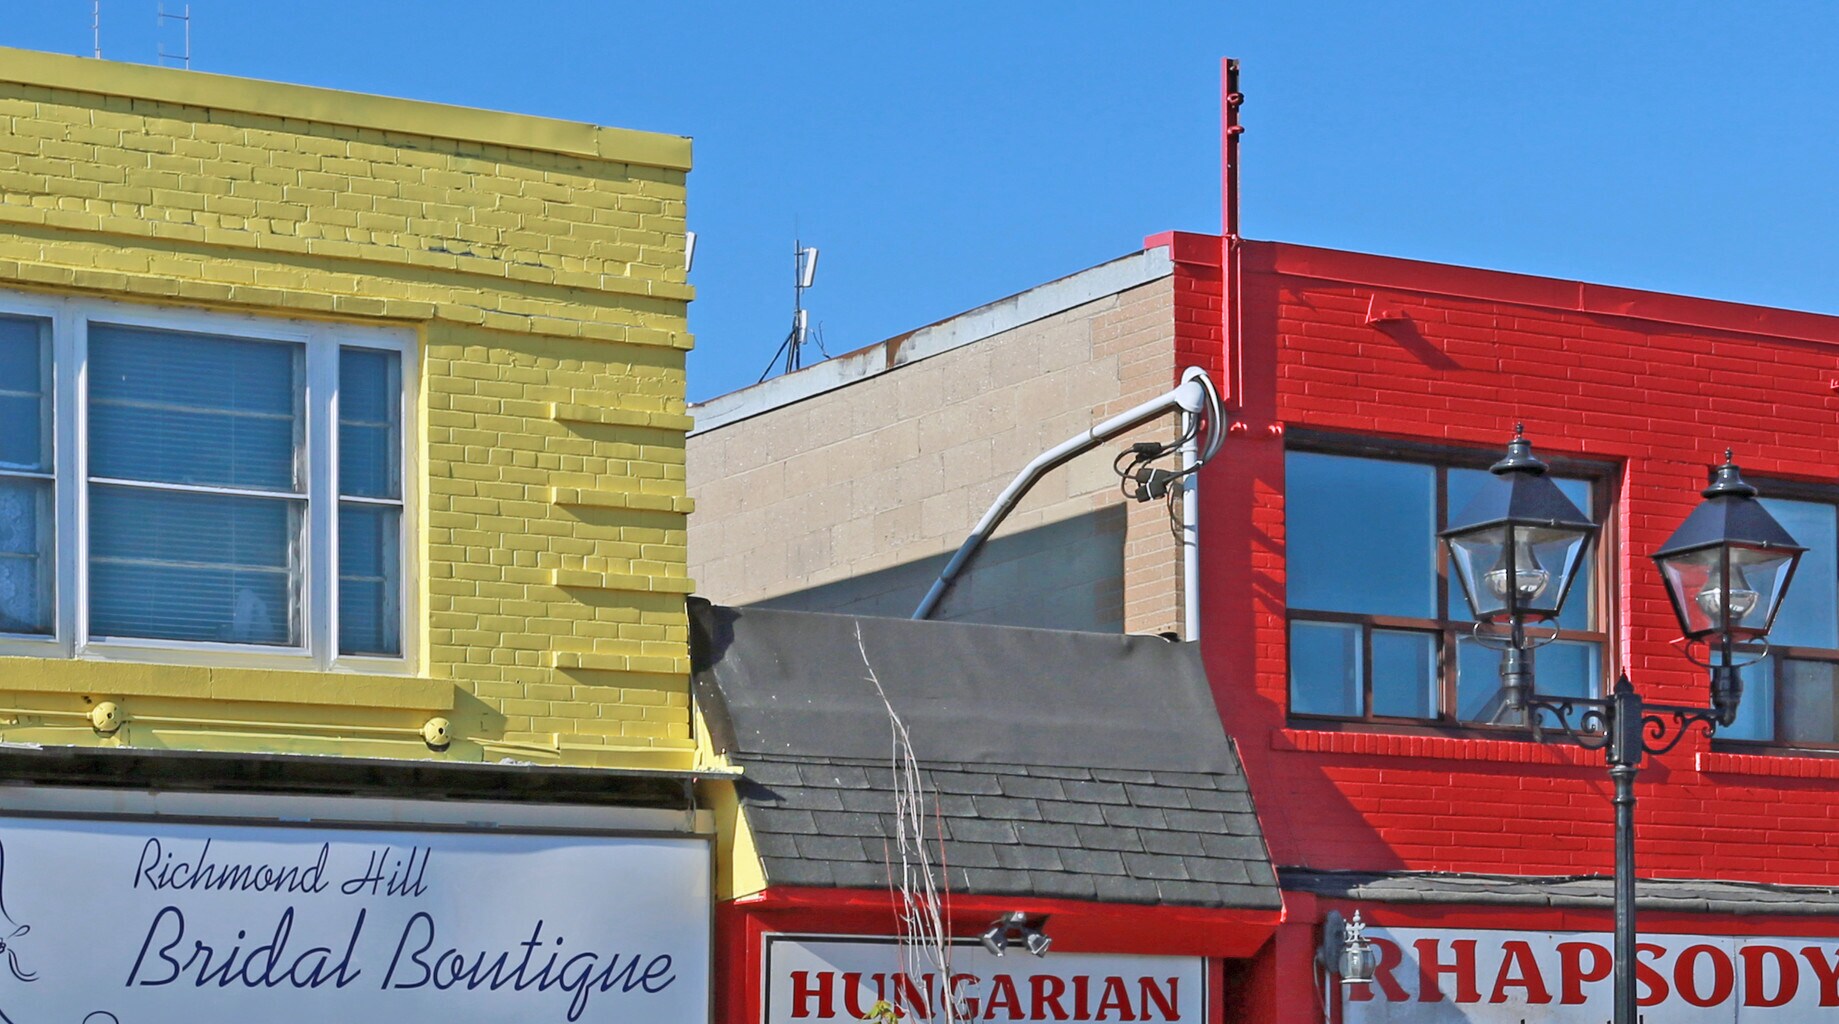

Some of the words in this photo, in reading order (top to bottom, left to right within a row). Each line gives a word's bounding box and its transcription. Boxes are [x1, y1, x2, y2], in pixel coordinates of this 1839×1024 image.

[133, 837, 330, 894] Richmond
[340, 845, 432, 898] Hill
[125, 905, 368, 989] Bridal
[380, 910, 677, 1023] Boutique
[789, 970, 1182, 1022] HUNGARIAN
[1348, 937, 1839, 1007] RHAPSODY
